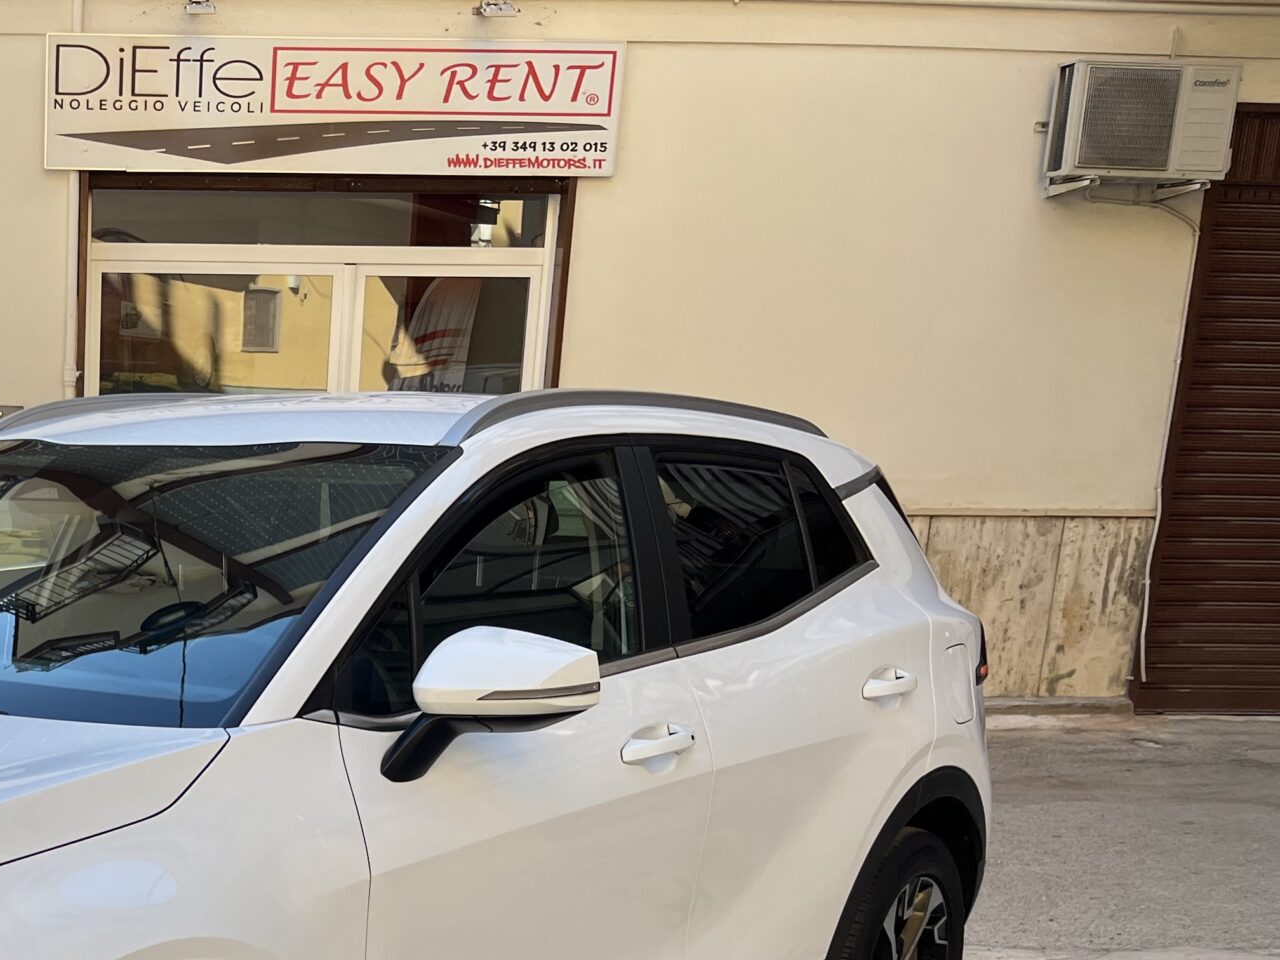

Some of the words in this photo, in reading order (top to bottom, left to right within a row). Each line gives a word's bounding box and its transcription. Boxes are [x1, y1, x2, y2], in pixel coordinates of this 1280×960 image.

[54, 43, 264, 99] DiEffe
[283, 60, 425, 102] EASY
[440, 60, 605, 103] RENT
[53, 98, 165, 112] NOLEGGIO
[177, 100, 264, 114] VEICOLI
[481, 140, 507, 152] +39
[511, 141, 537, 152] 349
[541, 141, 556, 152] 13
[559, 141, 578, 153] 02
[583, 141, 608, 153] 015
